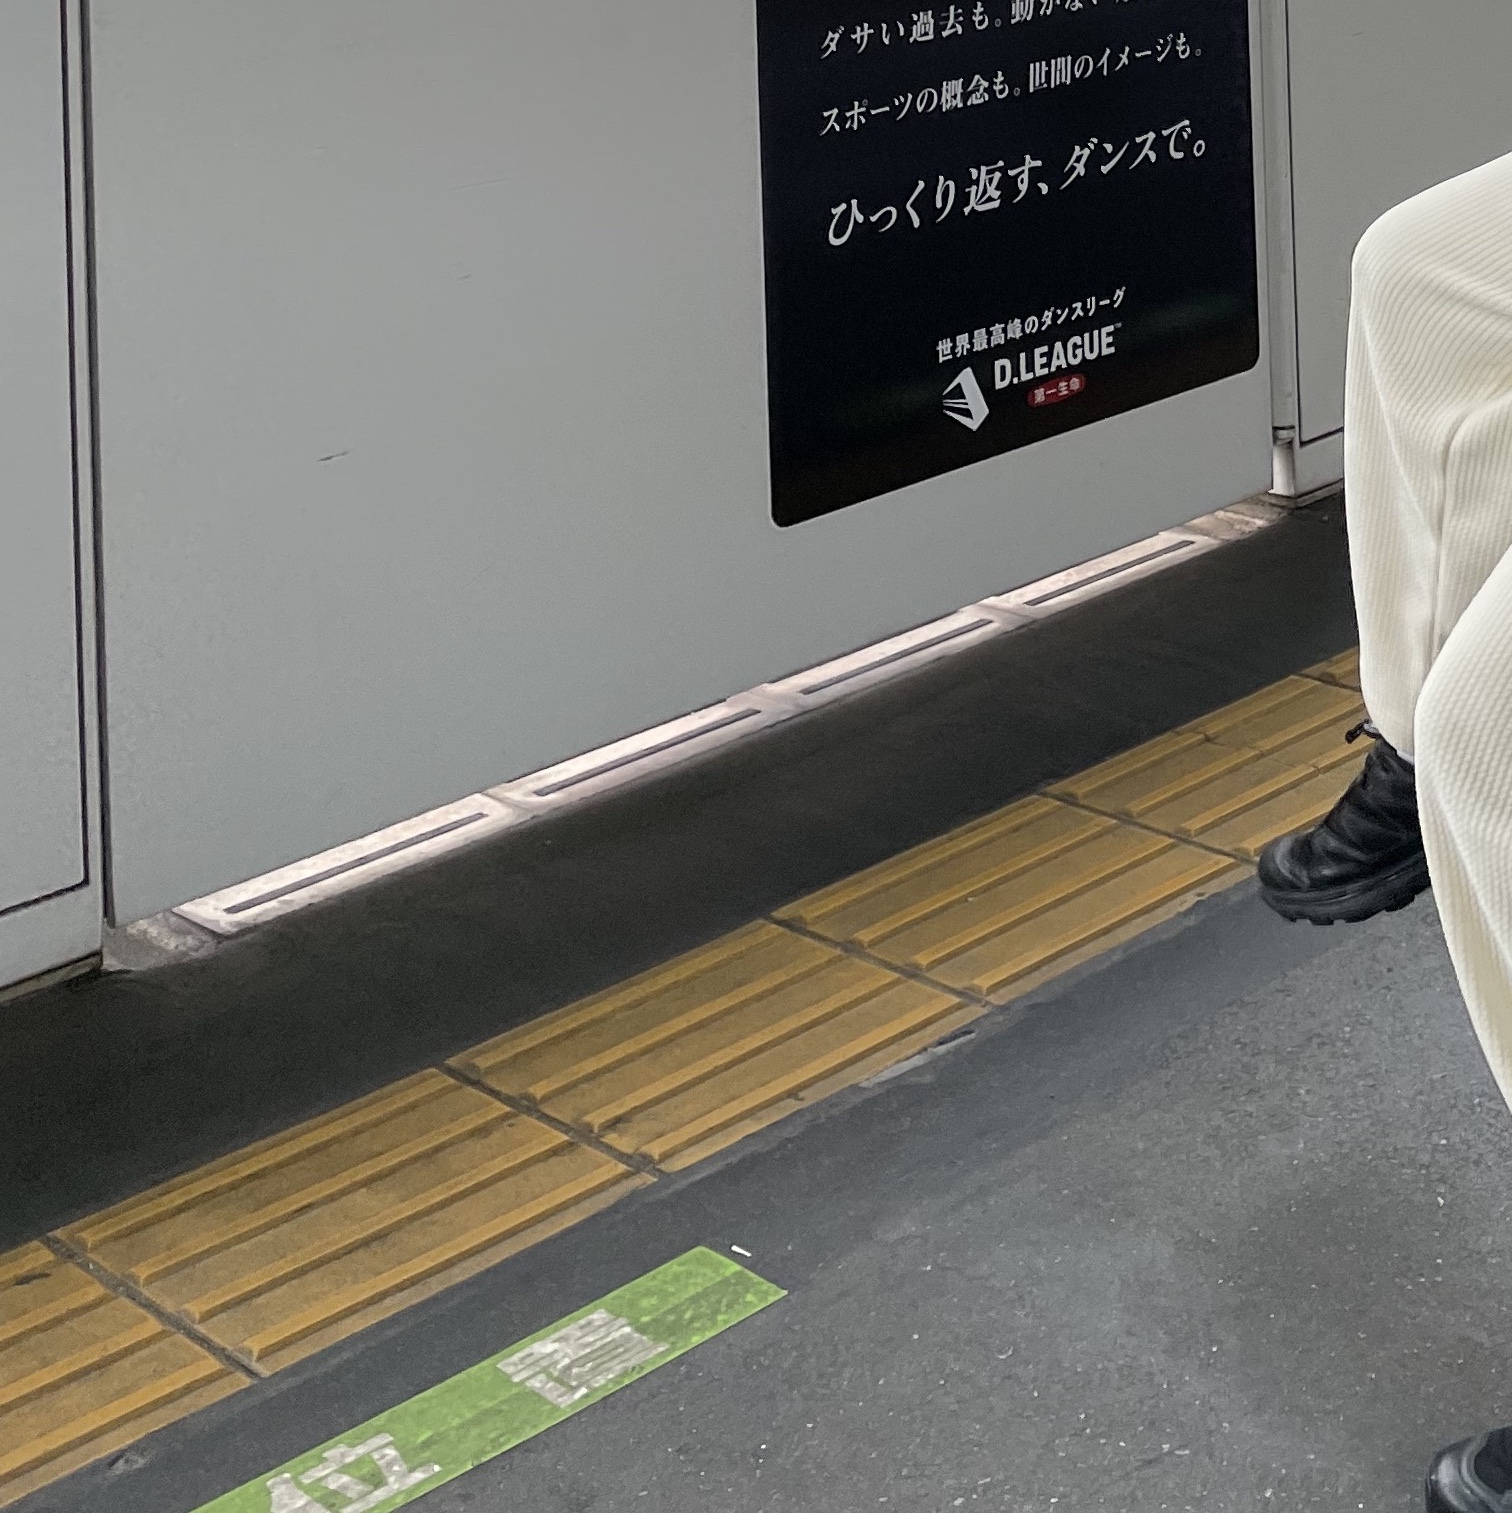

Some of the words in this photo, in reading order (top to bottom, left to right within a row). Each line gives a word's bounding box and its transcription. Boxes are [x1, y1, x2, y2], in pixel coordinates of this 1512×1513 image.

[936, 286, 1126, 363] 世界最高峰のダンスリーグ
[1033, 377, 1080, 404] 第一生命
